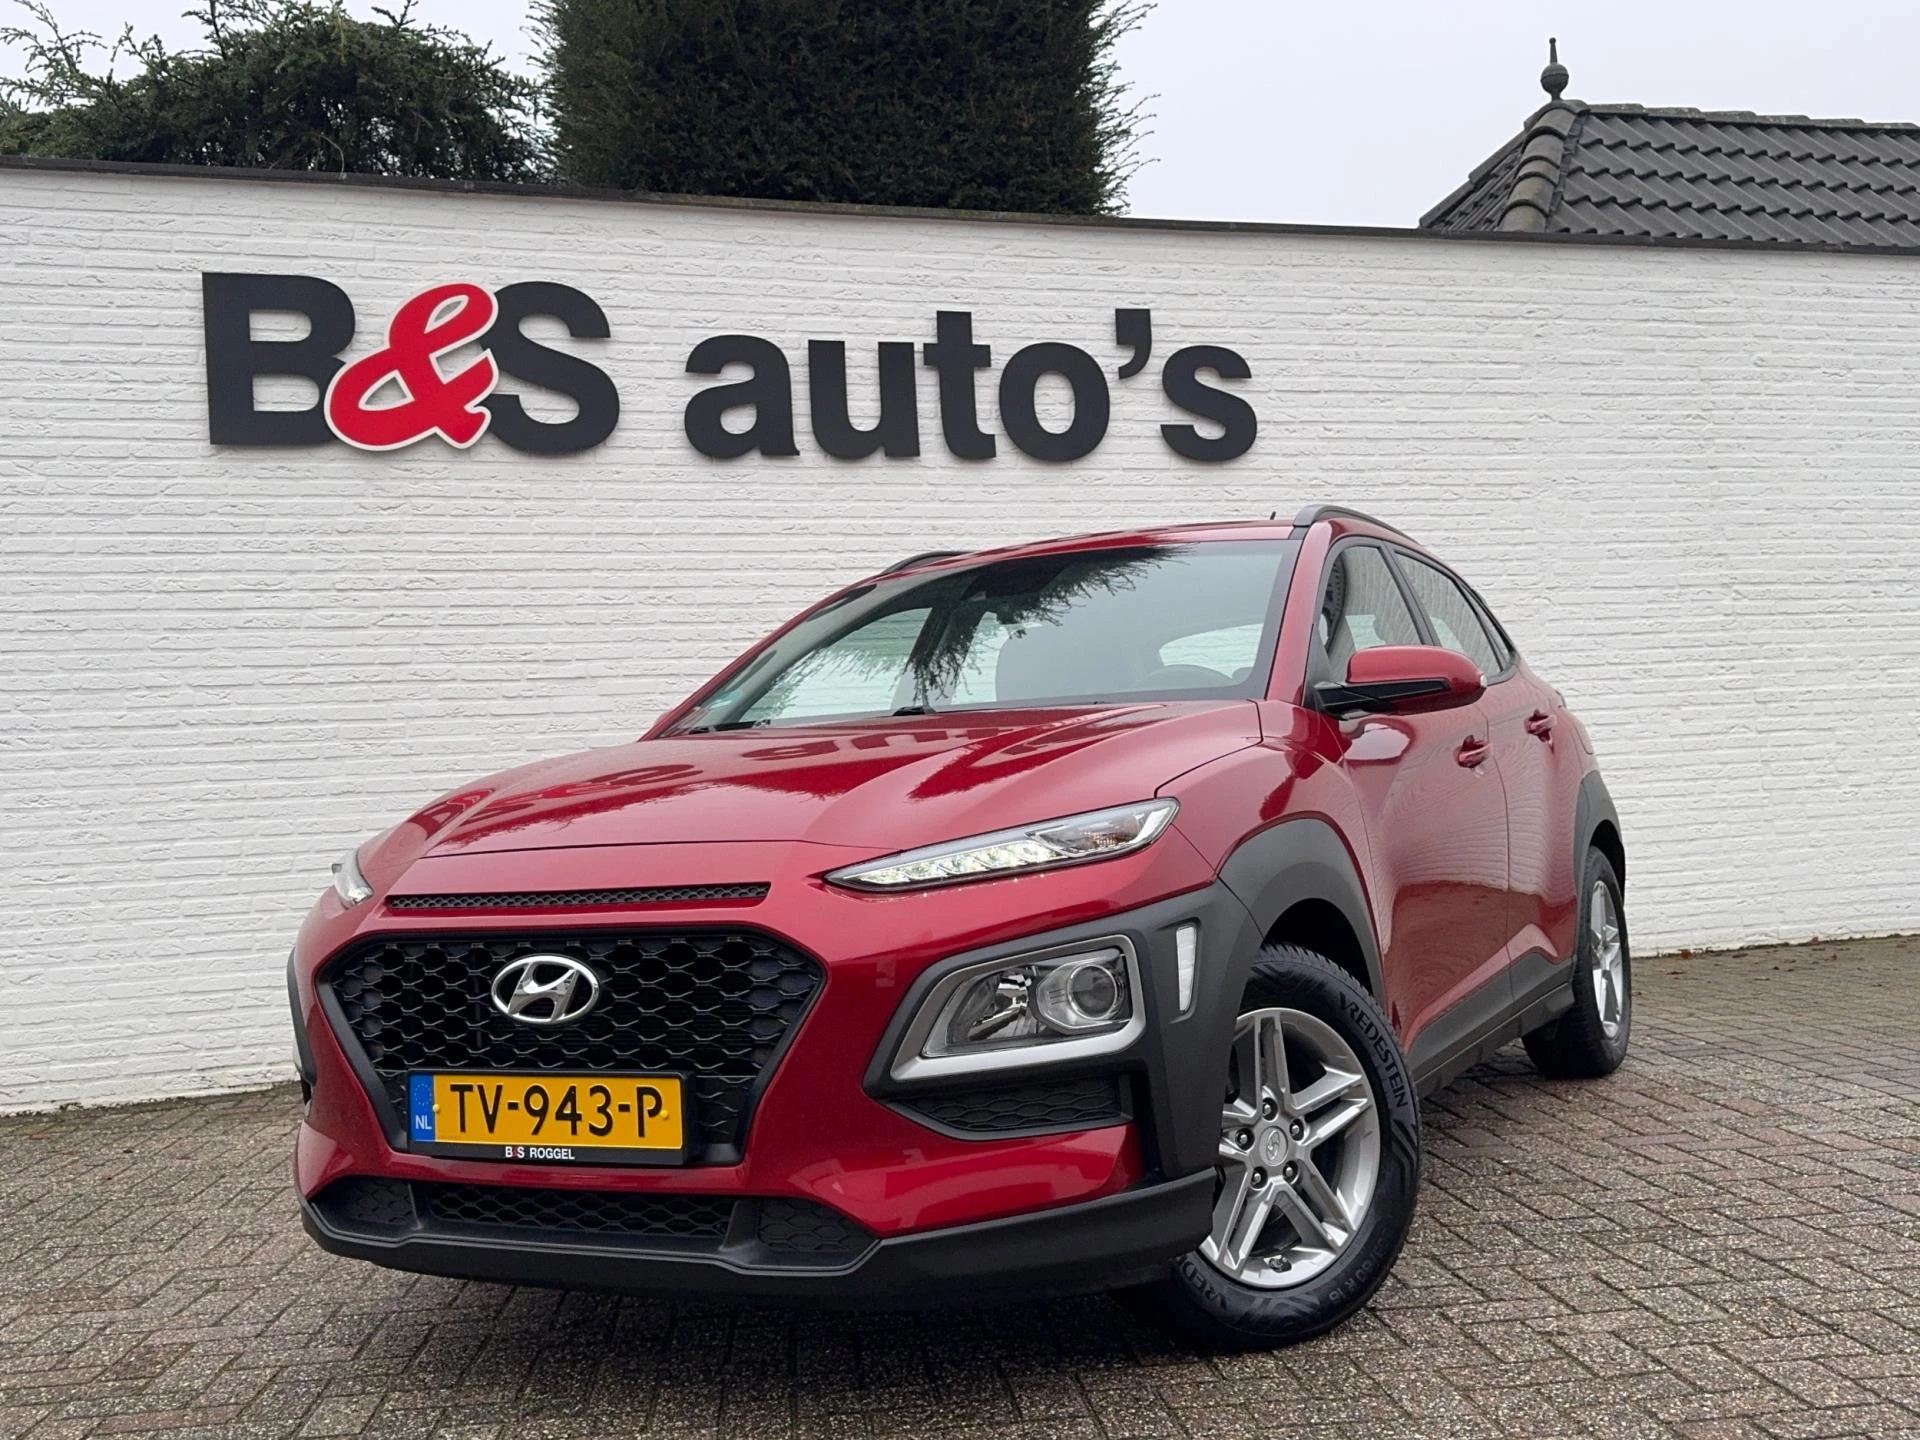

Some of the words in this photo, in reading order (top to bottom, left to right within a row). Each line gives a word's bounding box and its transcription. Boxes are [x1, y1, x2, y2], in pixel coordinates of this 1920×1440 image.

[201, 271, 621, 455] B&S
[685, 307, 1258, 463] auto's
[1339, 992, 1408, 1108] VREDESTEIN
[415, 1115, 433, 1130] NL
[450, 1083, 663, 1138] TV-943-P
[529, 1147, 576, 1160] ROGGEL
